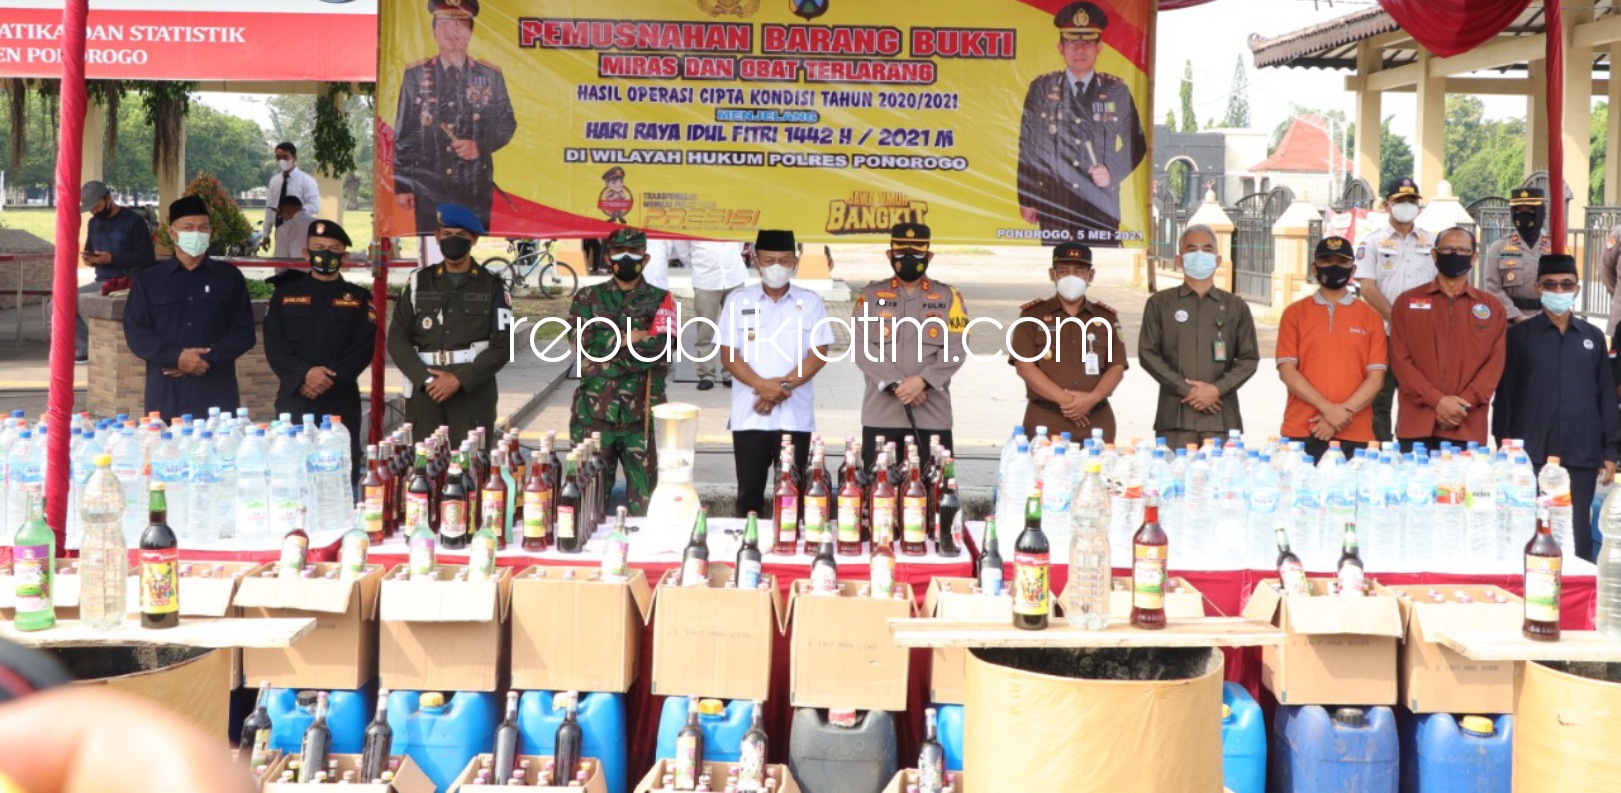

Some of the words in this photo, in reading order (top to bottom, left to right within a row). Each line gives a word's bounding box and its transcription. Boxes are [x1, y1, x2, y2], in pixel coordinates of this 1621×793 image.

[129, 25, 246, 43] STATISTIK
[519, 19, 751, 51] PEMUSNAHAN
[763, 25, 901, 55] BARANG
[911, 28, 1014, 57] BUKTI
[26, 47, 148, 65] POROGO
[600, 55, 678, 78] MIRAS
[683, 57, 735, 80] DAN
[739, 58, 799, 81] OBAT
[804, 60, 935, 83] TERLARANG
[577, 84, 622, 102] HASIL
[626, 86, 694, 105] OPERASI
[699, 88, 745, 106] CIPTA
[749, 88, 815, 107] KONDISI
[820, 91, 873, 108] TAHUN
[877, 92, 959, 110] 2020/2021
[716, 109, 818, 123] MENJELANG
[585, 121, 628, 140] HARI
[633, 122, 681, 142] RAYA
[686, 124, 727, 143] IDUL
[731, 125, 778, 144] FITRI
[784, 126, 833, 145] 1442
[838, 127, 852, 145] H
[857, 127, 874, 147] /
[877, 127, 930, 147] 2021
[933, 129, 955, 149] M
[565, 149, 587, 163] DI
[592, 149, 682, 165] WILAYAH
[686, 151, 764, 167] HUKUM
[769, 153, 848, 168] POLRES
[853, 155, 968, 171] PONOROGO
[825, 199, 928, 236] BANGKIT
[997, 229, 1074, 240] PONOROGO,
[1077, 230, 1085, 240] 5
[1088, 230, 1111, 241] MEI
[1114, 231, 1144, 242] 2021
